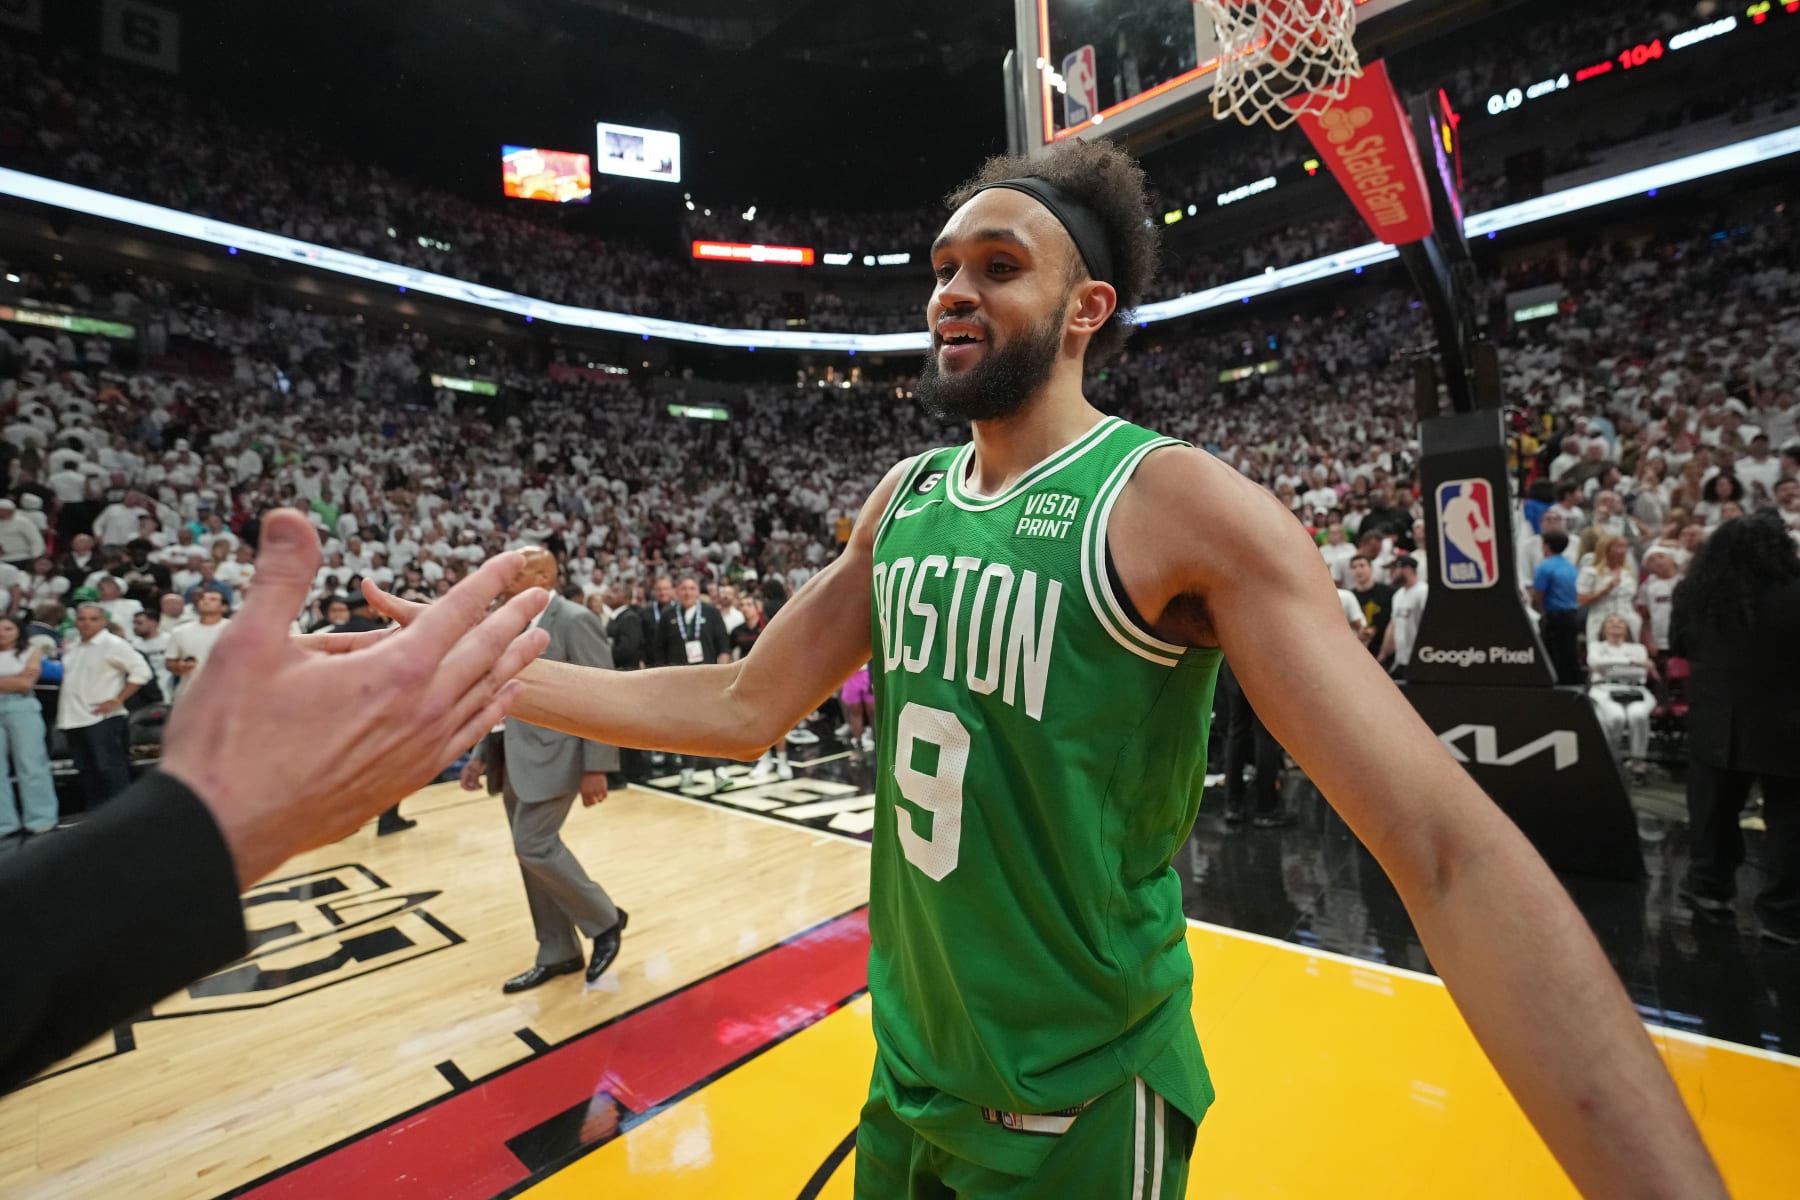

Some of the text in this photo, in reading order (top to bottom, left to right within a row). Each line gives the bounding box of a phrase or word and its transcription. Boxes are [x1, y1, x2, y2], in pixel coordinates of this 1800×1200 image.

[1618, 39, 1663, 69] 104
[1487, 88, 1523, 114] 0.0
[918, 473, 945, 492] 6
[1024, 493, 1080, 520] VISTA
[1015, 517, 1072, 539] PRINT
[1450, 562, 1478, 582] NBA
[873, 555, 1062, 722] BOSTON
[1418, 646, 1535, 667] Google Pixel
[894, 701, 971, 882] 9
